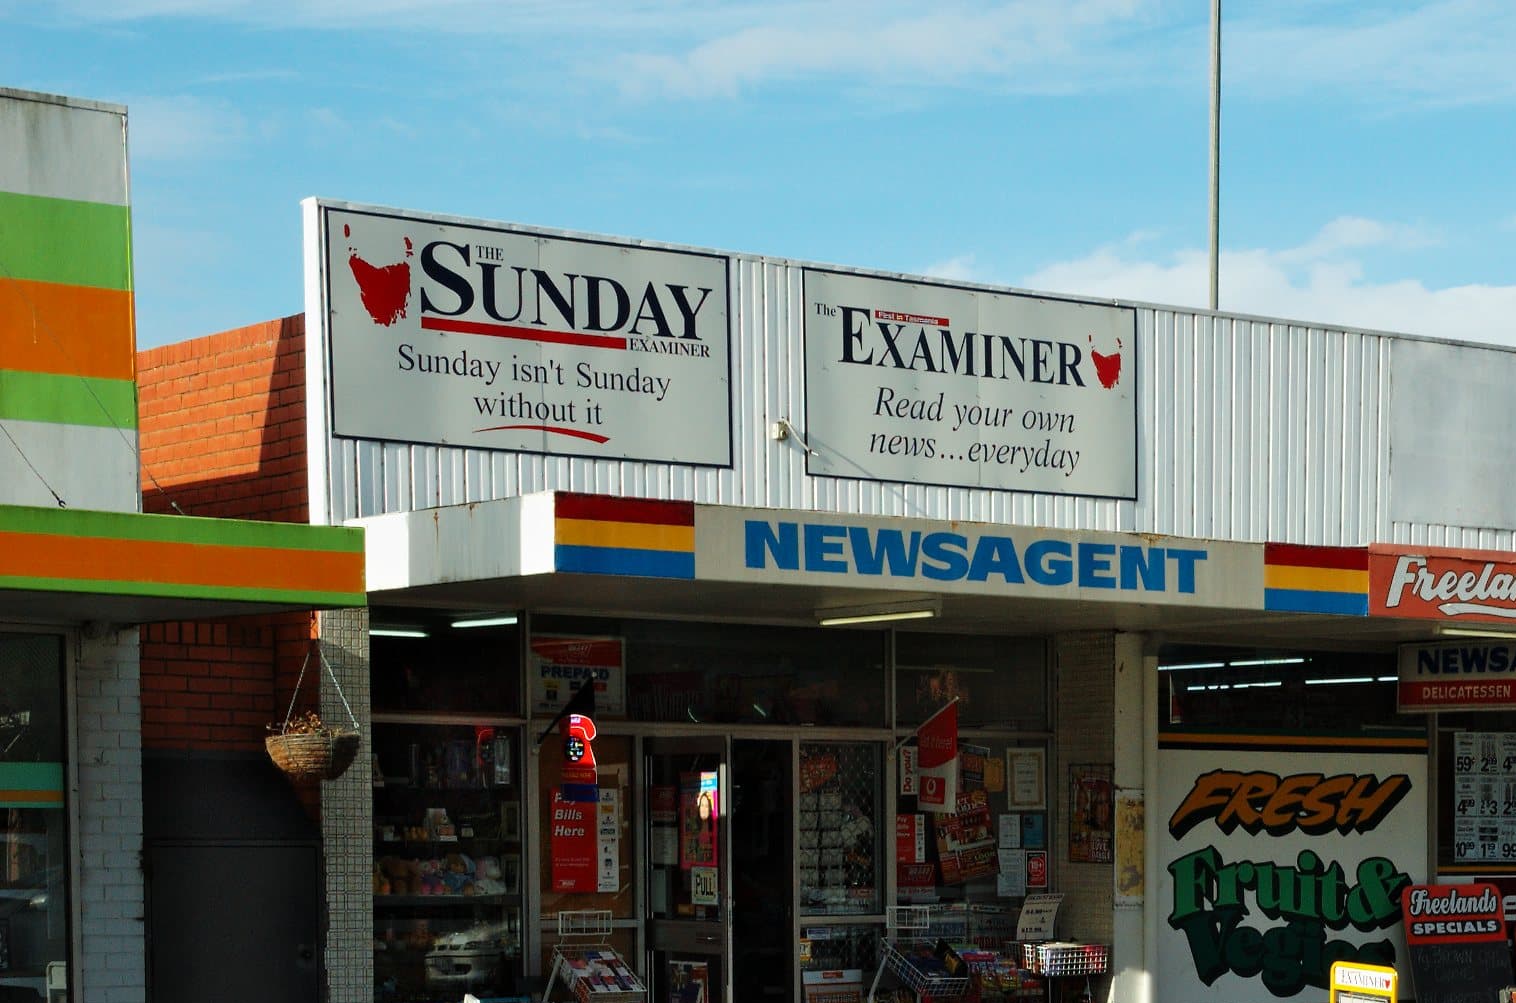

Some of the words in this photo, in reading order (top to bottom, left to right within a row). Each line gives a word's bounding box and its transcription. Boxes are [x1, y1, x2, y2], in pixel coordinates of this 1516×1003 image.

[476, 245, 503, 262] THE
[420, 241, 712, 340] SUNDAY
[814, 302, 836, 317] The
[630, 338, 710, 358] EXAMINER
[837, 305, 1086, 388] EXAMINER
[398, 344, 501, 385] Sunday
[512, 355, 565, 386] isn't
[576, 362, 671, 401] Sunday
[474, 393, 576, 424] without
[585, 398, 603, 425] it
[873, 386, 944, 422] Read
[952, 402, 1012, 431] your
[1022, 409, 1075, 433] own
[744, 519, 1208, 594] NEWSAGENT
[1422, 685, 1511, 699] DELICATESSEN
[554, 809, 582, 821] Bills
[1169, 768, 1412, 841] FRESH
[554, 826, 585, 837] Here
[695, 875, 714, 896] PULL
[1168, 845, 1349, 930] Fruit
[1410, 888, 1497, 917] Freelands
[1413, 920, 1498, 935] SPECIALS
